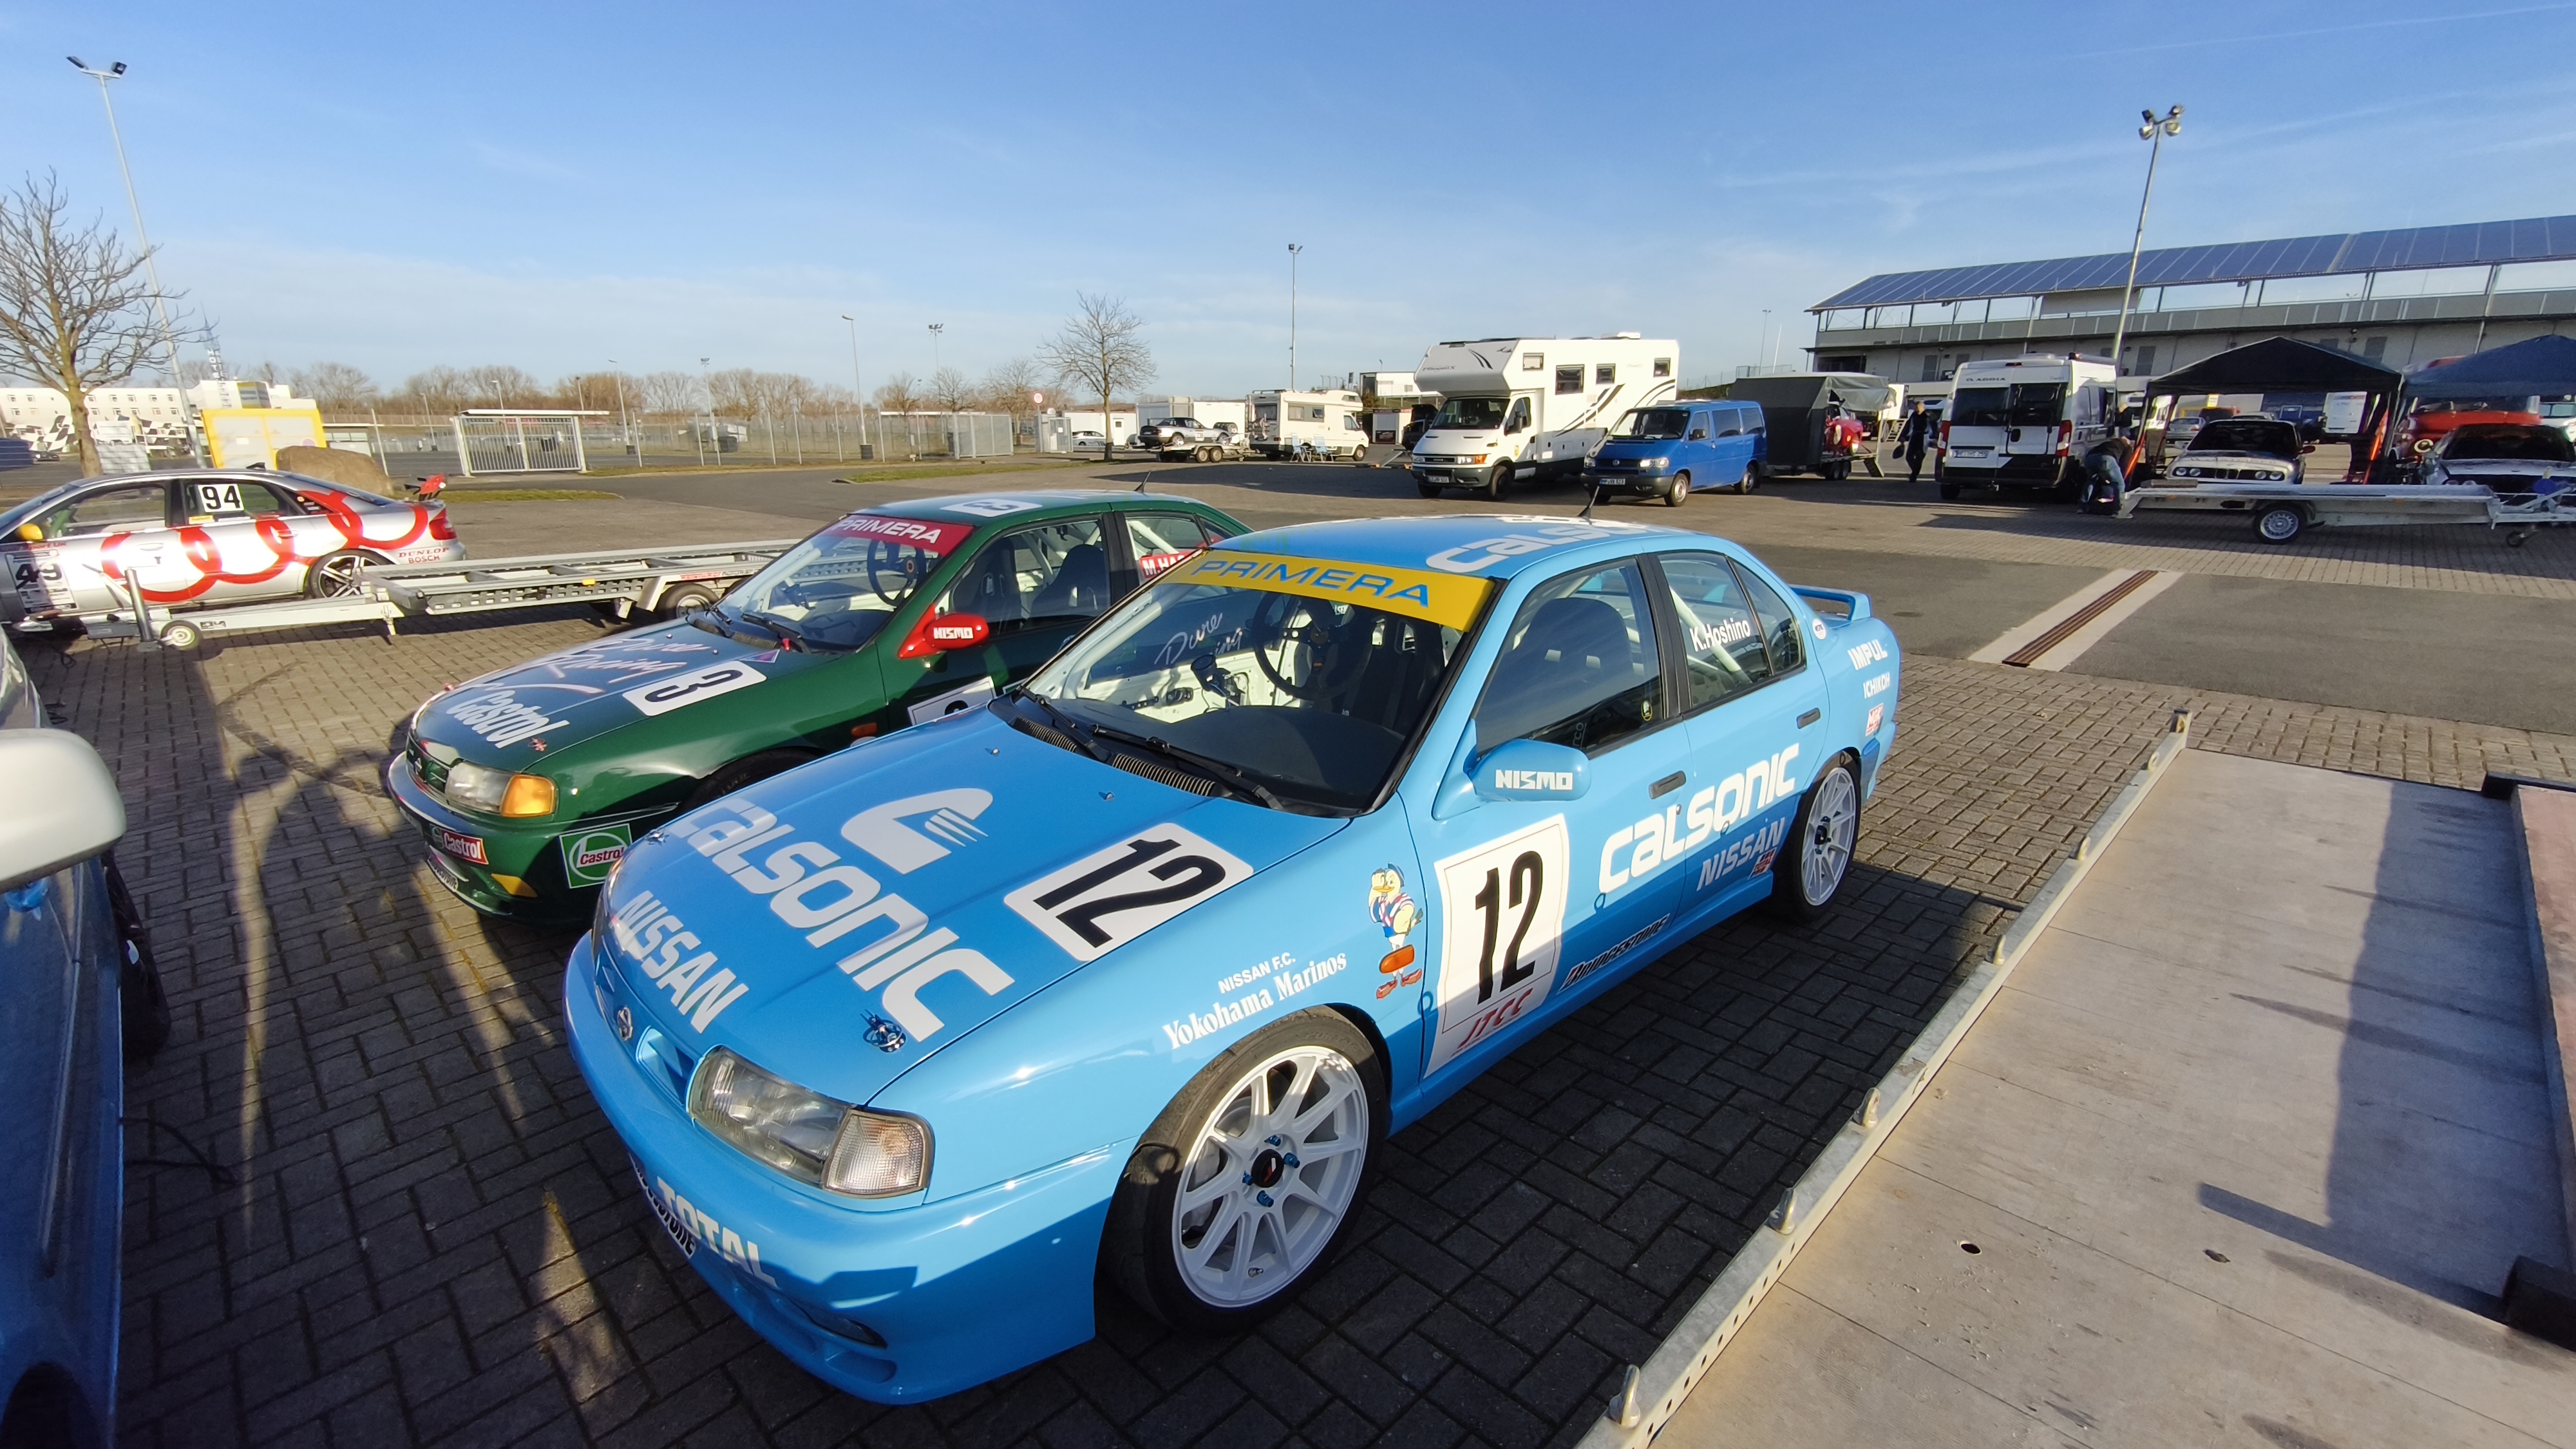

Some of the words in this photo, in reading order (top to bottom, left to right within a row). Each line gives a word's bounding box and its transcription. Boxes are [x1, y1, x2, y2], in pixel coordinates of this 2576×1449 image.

[202, 485, 240, 510] 94
[834, 518, 942, 544] PRIMERA
[399, 547, 450, 558] DUNLOP
[408, 554, 440, 565] BOSCH
[1191, 560, 1430, 609] PRIMERA
[934, 627, 974, 639] NISMO
[1689, 617, 1751, 652] K.Hoshino
[1847, 639, 1888, 671] IMPUL
[644, 669, 744, 703] 3
[1862, 672, 1890, 699] ICHIKOH
[446, 690, 571, 749] Castrol
[1495, 769, 1573, 790] NISMO
[443, 832, 482, 860] Castrol
[1696, 817, 1786, 892] NISSAN
[1032, 838, 1226, 949] 12
[1475, 850, 1543, 1005] 12
[616, 890, 750, 1034] NISSAN
[1218, 960, 1271, 994] NISSAN
[1271, 951, 1296, 971] F.C.
[1162, 988, 1274, 1050] Yokohama
[1273, 952, 1347, 1001] Marinos
[657, 1176, 779, 1289] TOTAL
